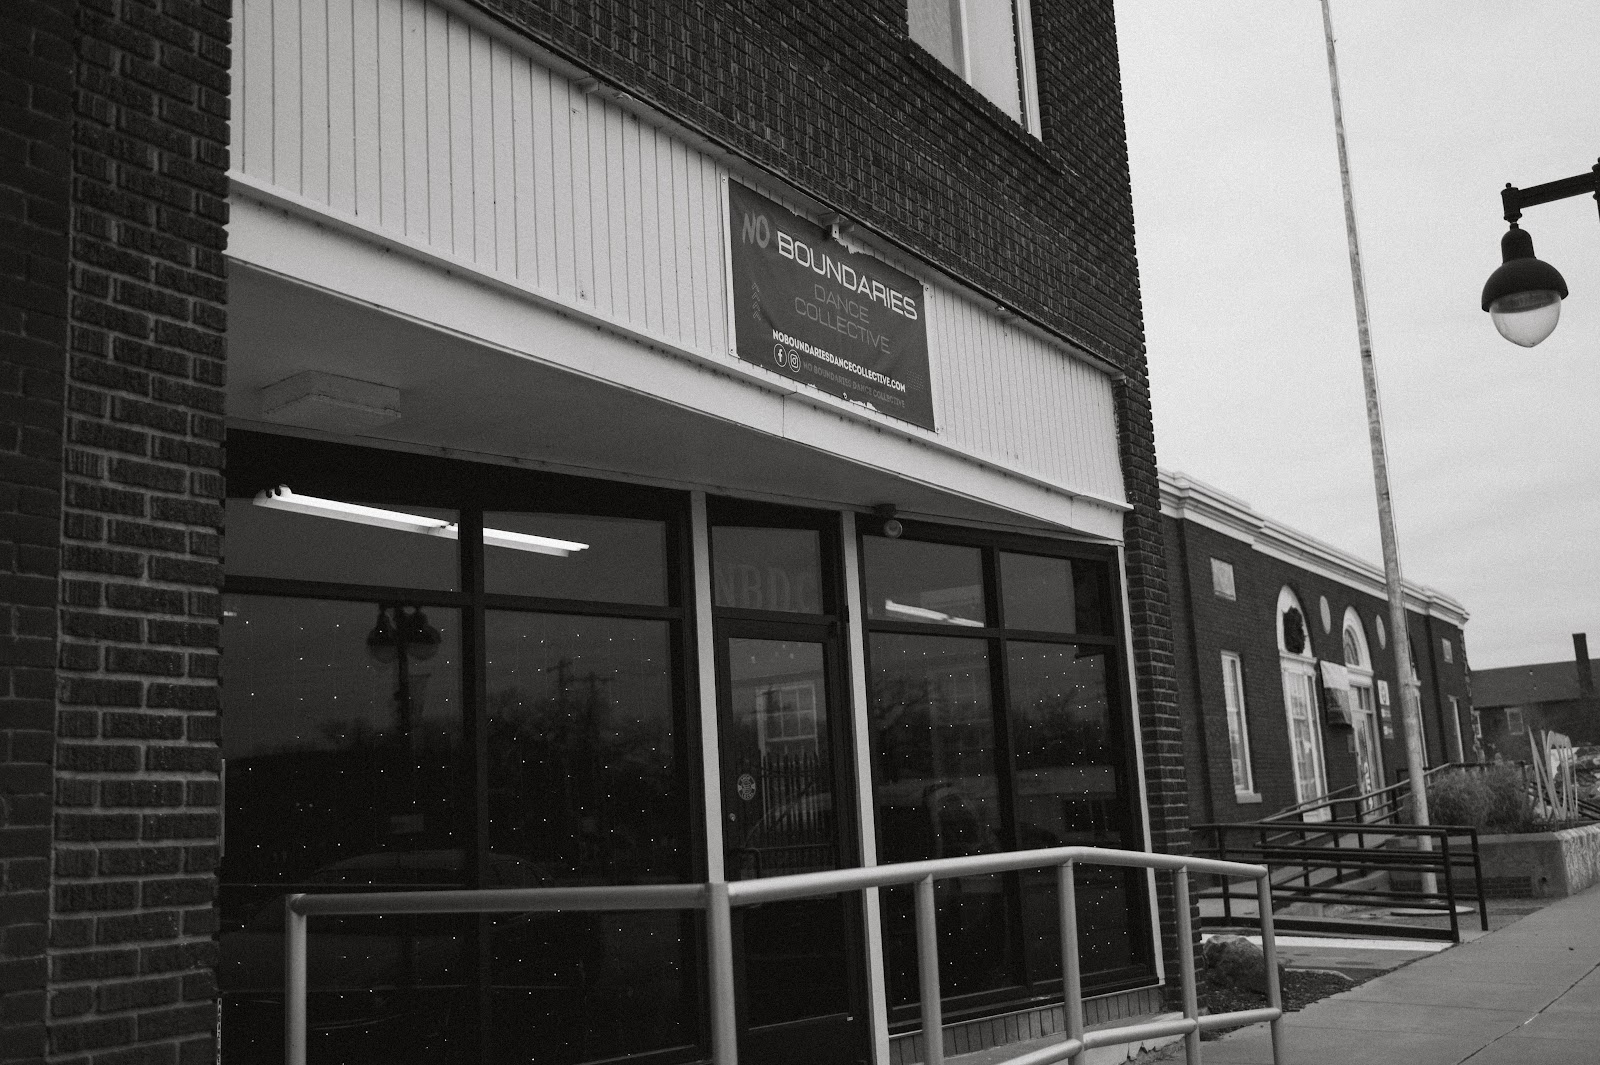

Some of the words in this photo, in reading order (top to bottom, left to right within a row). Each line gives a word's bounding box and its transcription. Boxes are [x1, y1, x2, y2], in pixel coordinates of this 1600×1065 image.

[742, 212, 770, 249] NO
[777, 230, 918, 321] BOUNDARIES
[795, 296, 890, 354] COLLECTIVE
[814, 284, 870, 324] DANCE
[772, 329, 906, 393] NOBOUNDARIESDANCECOLLECTIVE.COM
[803, 361, 813, 372] NO
[813, 365, 852, 388] BOUNDARIES
[852, 380, 872, 396] DANCE
[872, 389, 905, 408] COLLECTIVE
